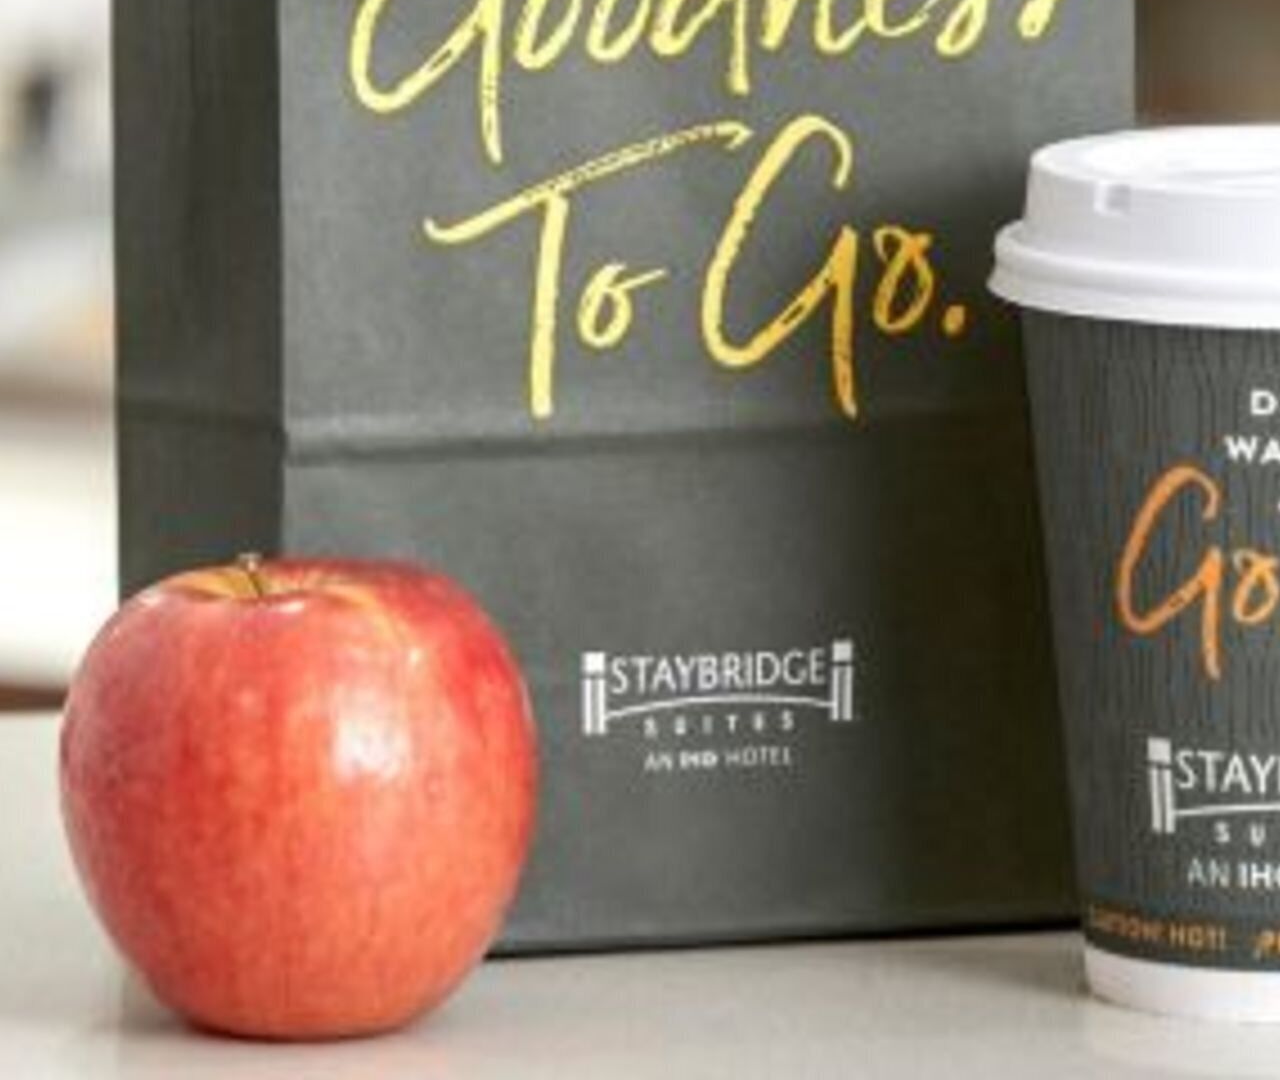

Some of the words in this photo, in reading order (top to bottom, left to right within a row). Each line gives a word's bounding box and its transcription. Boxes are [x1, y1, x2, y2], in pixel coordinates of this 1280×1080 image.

[423, 122, 753, 420] To
[701, 116, 967, 421] Go.
[609, 647, 826, 696] STAYBRIDGE
[1187, 857, 1232, 888] AN
